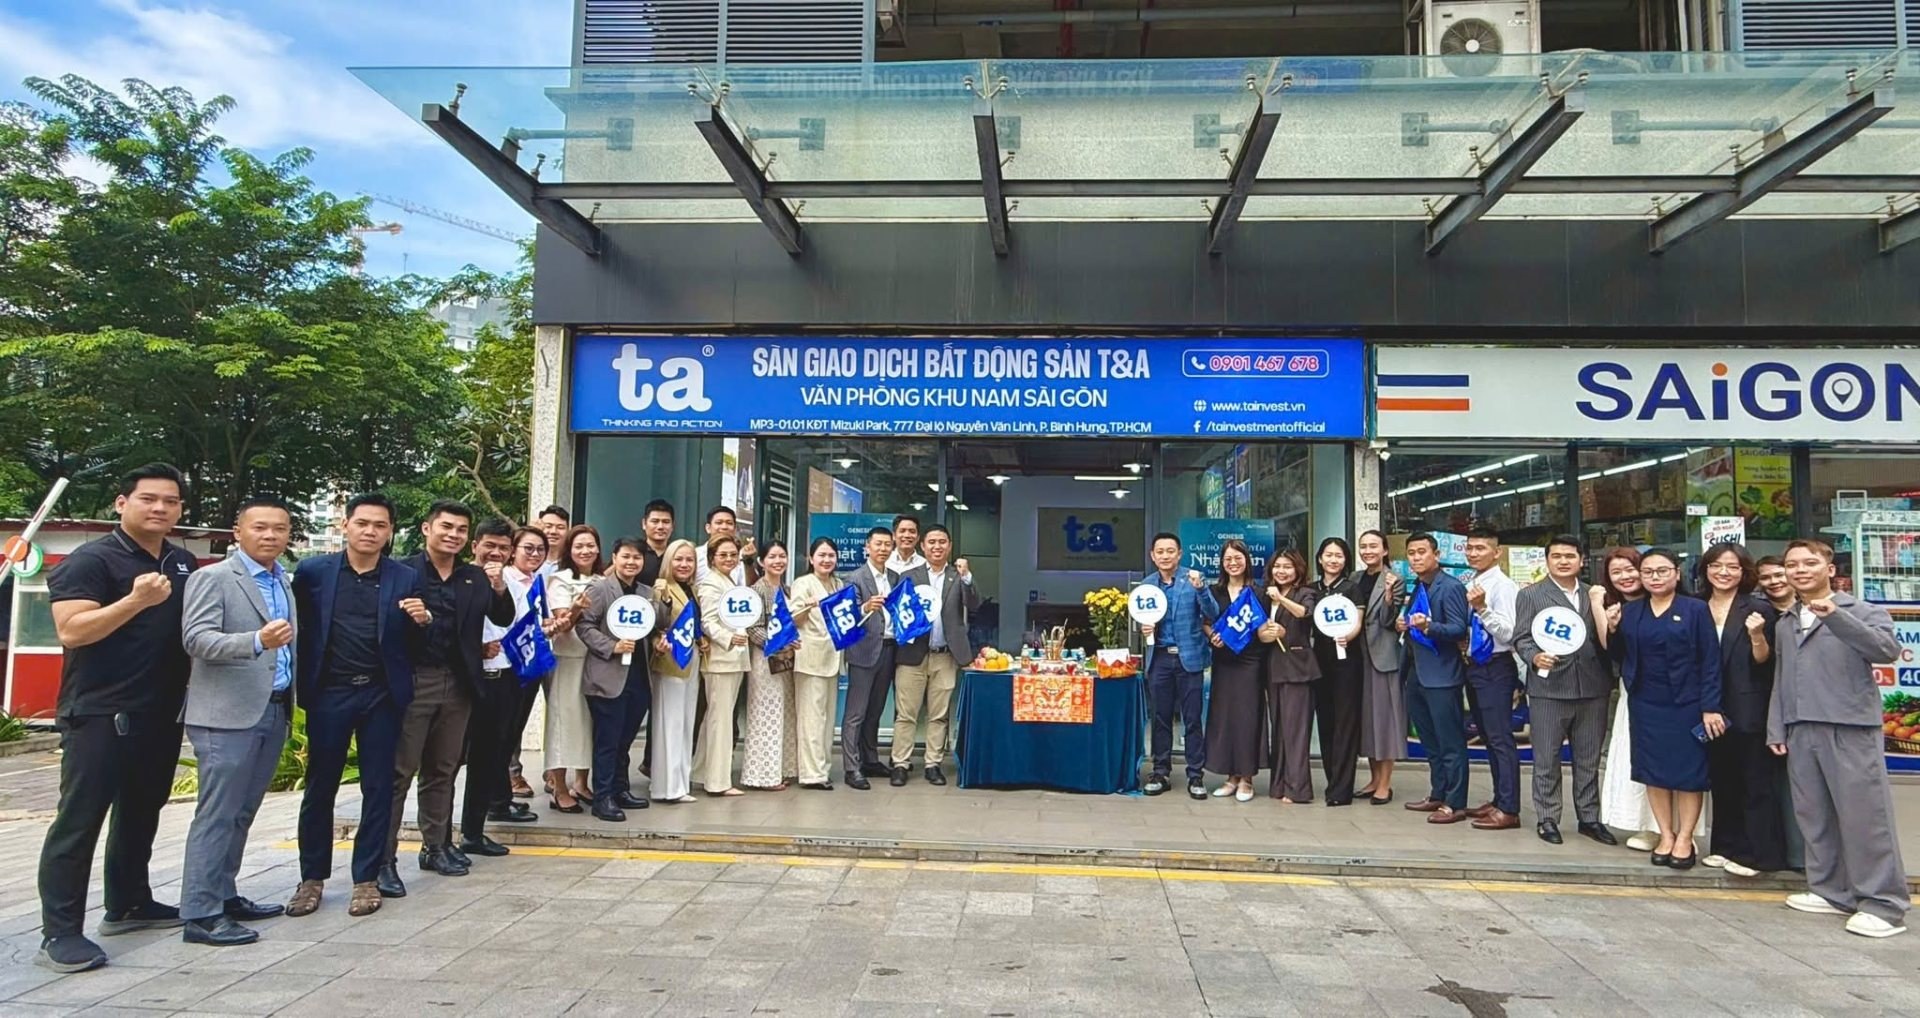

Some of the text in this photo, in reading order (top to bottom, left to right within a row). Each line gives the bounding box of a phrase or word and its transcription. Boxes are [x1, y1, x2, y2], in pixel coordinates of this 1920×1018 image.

[753, 343, 1151, 382] SÀN GIAO DỊCH BẤT ĐỘNG SẢN T&A
[1209, 355, 1319, 372] 0901 467 678
[612, 343, 713, 412] ta
[800, 384, 1107, 407] VĂN PHÒNG KHU NAM SÀI GÒN
[1211, 400, 1306, 412] www.tainvest.vn
[601, 419, 652, 427] THINKING
[681, 420, 723, 428] ACTION
[806, 419, 830, 430] KĐT
[831, 419, 864, 431] Mizuki
[893, 420, 914, 431] 777
[915, 420, 933, 432] Đại
[1040, 421, 1049, 432] P.
[1206, 421, 1325, 433] /tainvestmentofficial
[1364, 502, 1379, 510] 102
[1062, 515, 1118, 552] ta
[1709, 533, 1741, 547] SUSHI
[1190, 552, 1220, 568] Nhậ
[727, 596, 752, 613] ta
[1136, 594, 1158, 610] ta
[618, 605, 644, 625] ta
[832, 599, 856, 635] ta
[1227, 604, 1254, 633] ta
[1323, 606, 1348, 623] ta
[1544, 616, 1572, 641] ta
